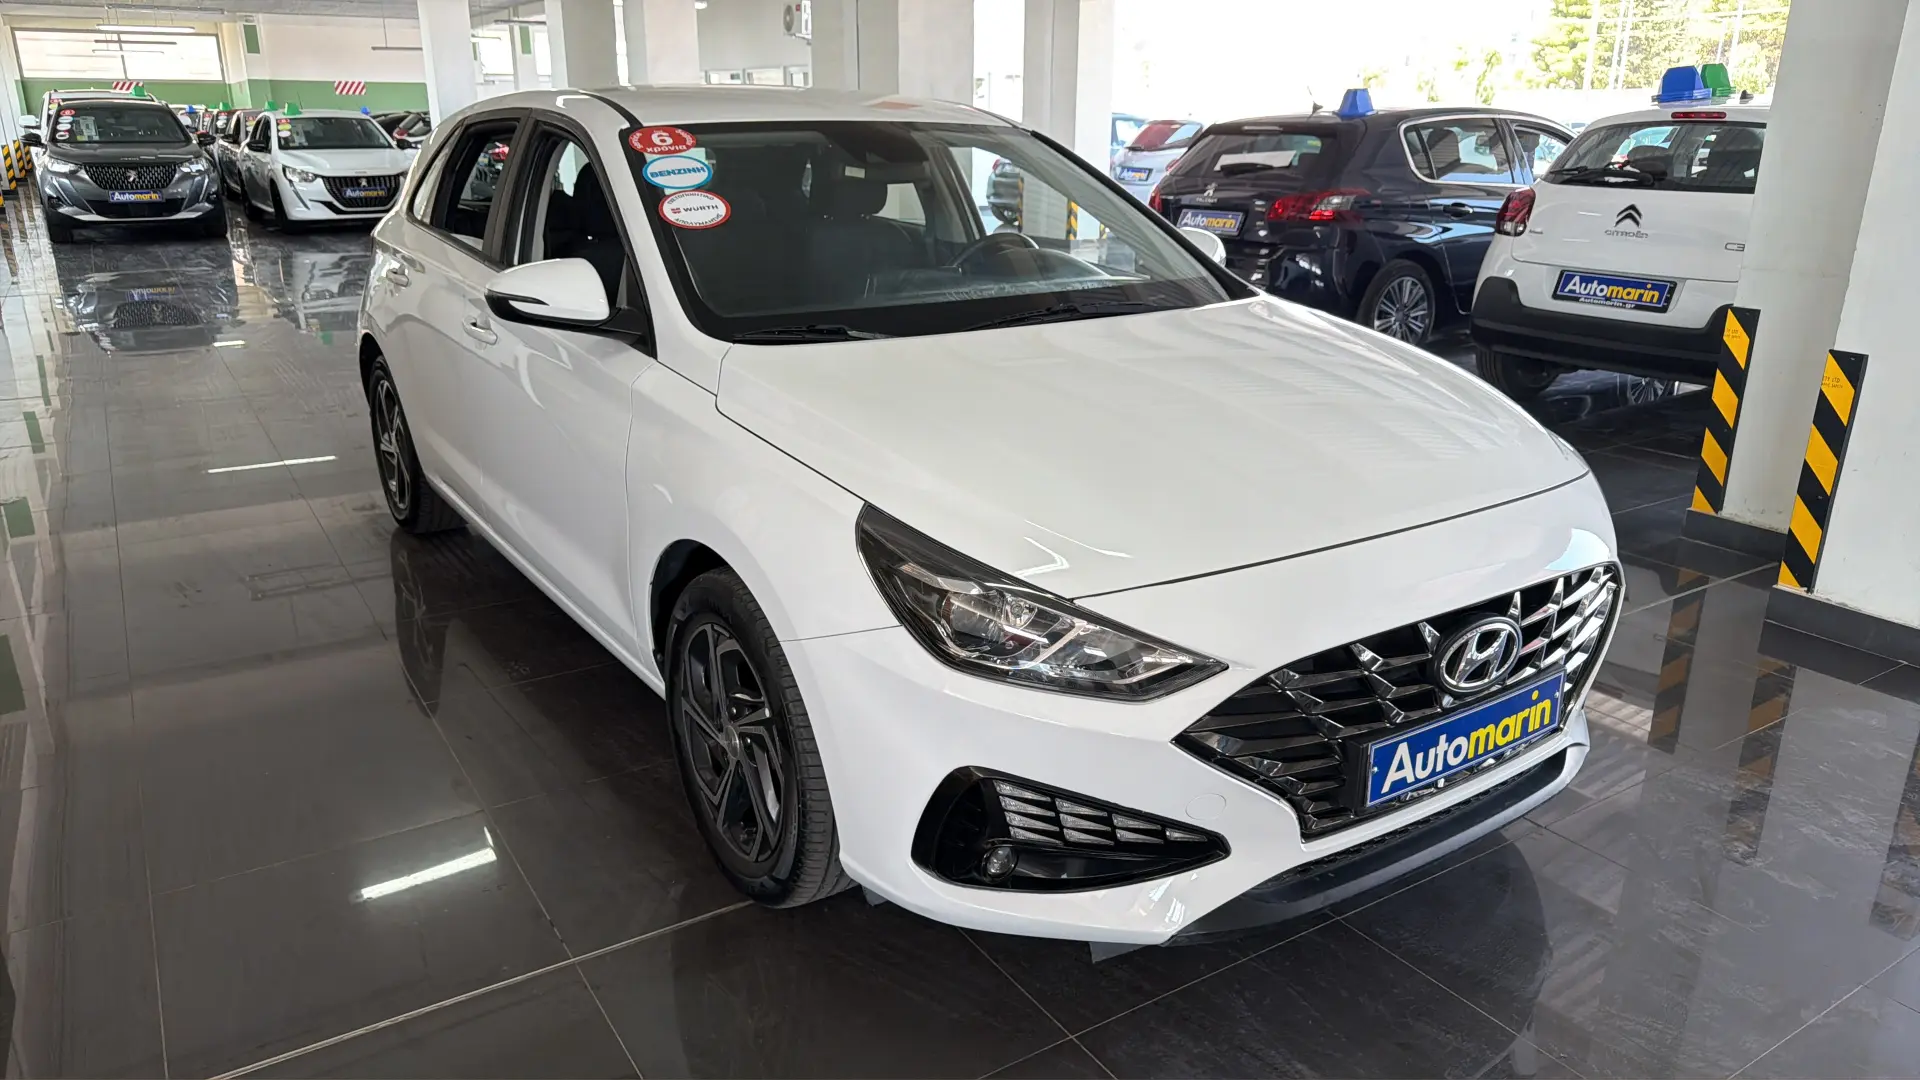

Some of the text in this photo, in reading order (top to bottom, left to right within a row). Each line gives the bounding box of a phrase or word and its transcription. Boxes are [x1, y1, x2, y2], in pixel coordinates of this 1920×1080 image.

[651, 132, 673, 146] 6
[646, 144, 687, 153] χρόνια
[114, 191, 159, 201] Automarin
[1181, 211, 1236, 228] Automarin
[1724, 242, 1746, 252] C3
[1564, 275, 1660, 304] Automarin
[1381, 690, 1552, 794] Automarin
